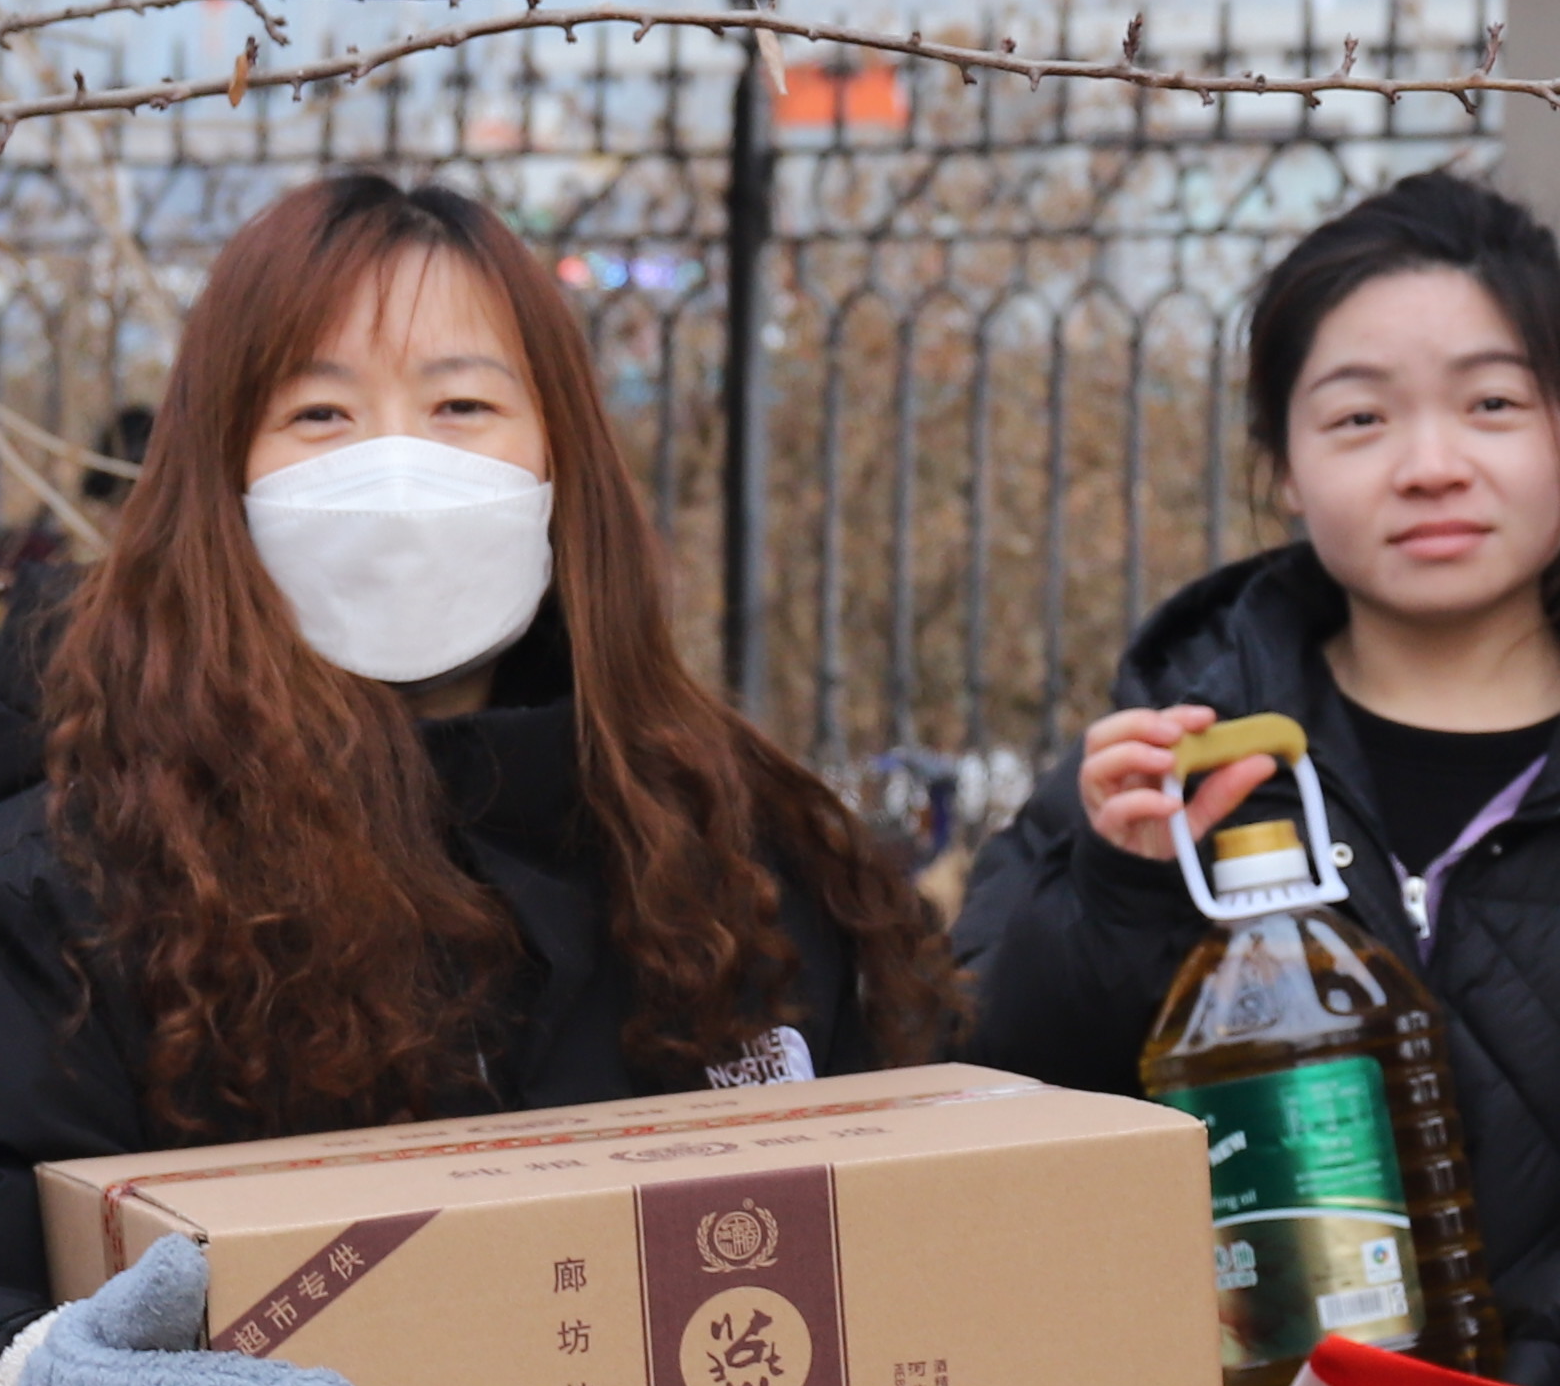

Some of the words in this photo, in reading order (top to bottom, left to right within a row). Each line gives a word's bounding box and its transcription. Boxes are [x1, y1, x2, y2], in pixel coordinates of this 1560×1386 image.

[705, 1051, 791, 1089] NORTH
[233, 1242, 367, 1356] 超市专供
